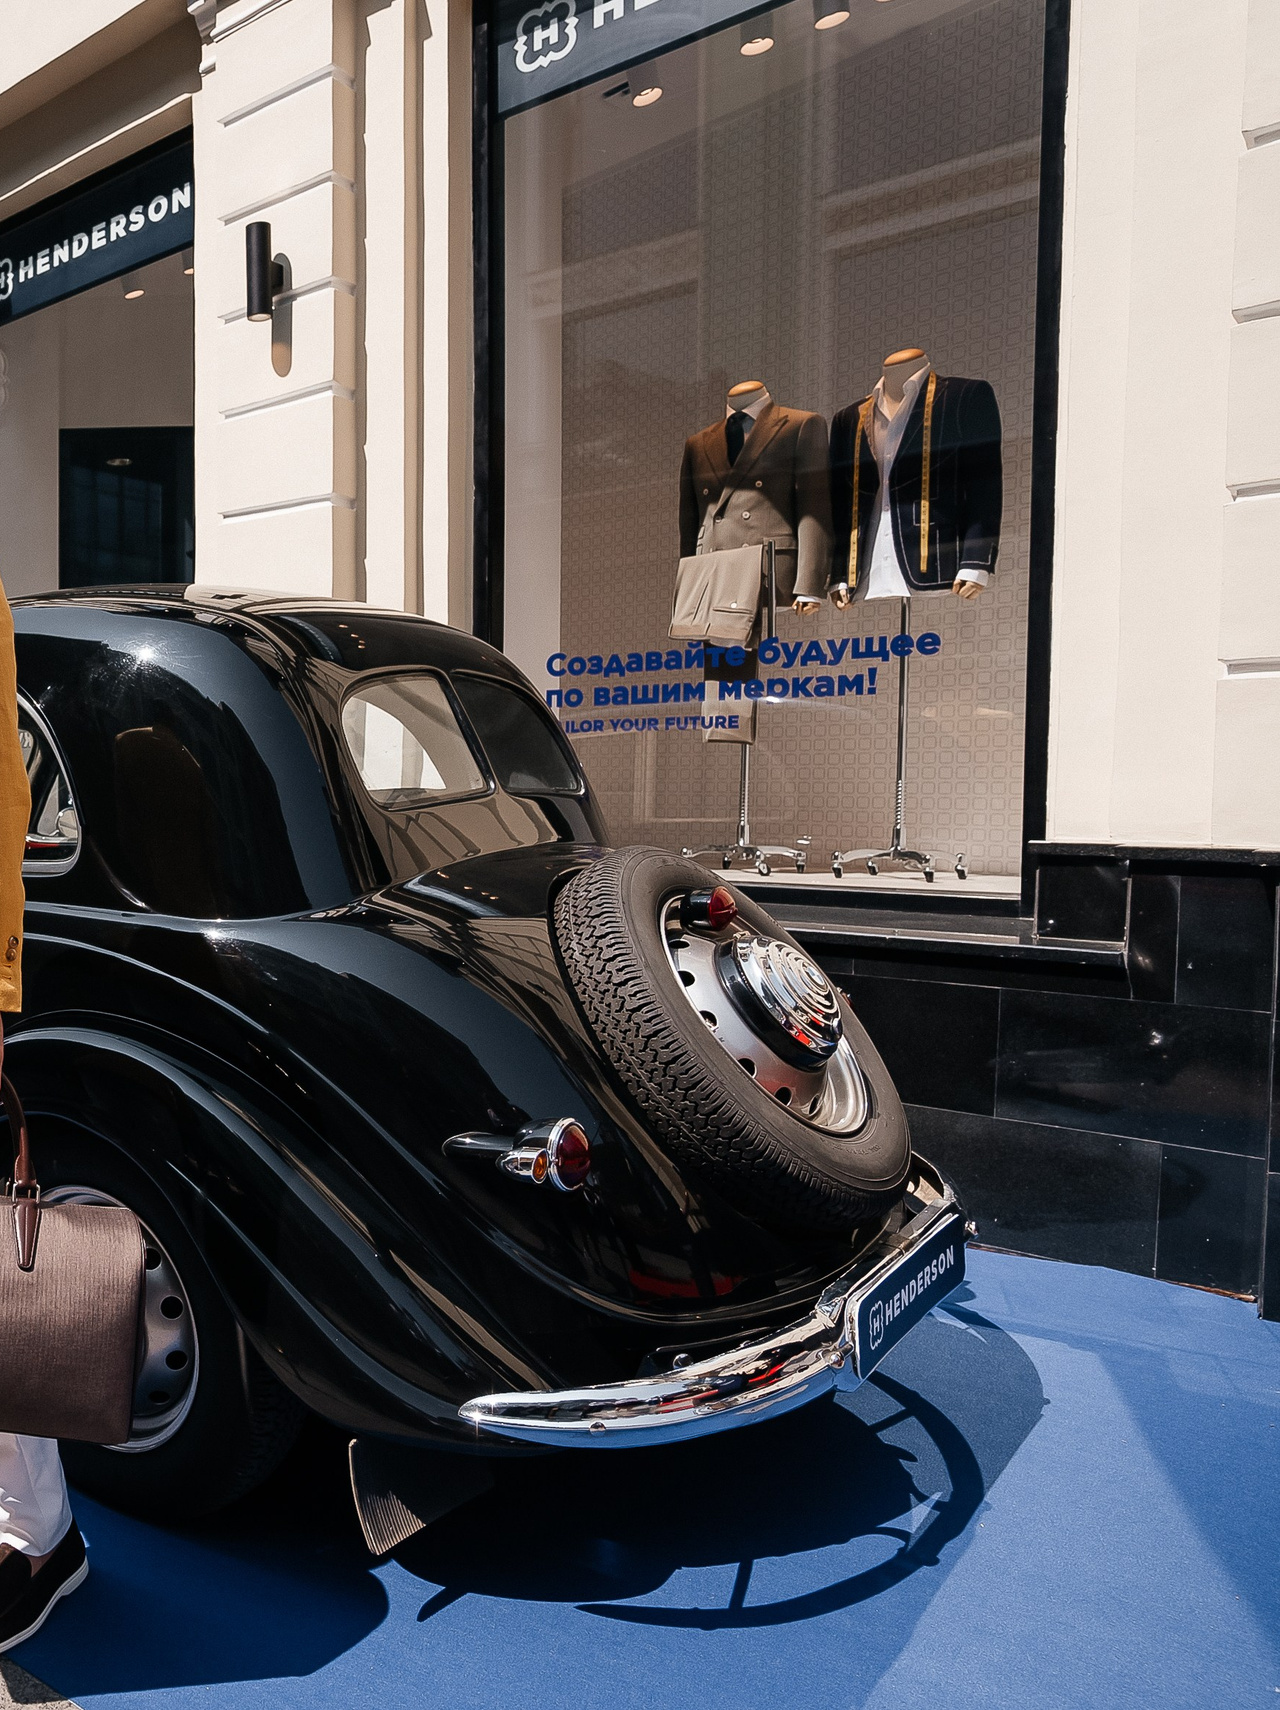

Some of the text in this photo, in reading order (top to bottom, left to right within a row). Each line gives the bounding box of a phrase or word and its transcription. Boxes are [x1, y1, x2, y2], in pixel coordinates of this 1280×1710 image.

[18, 182, 191, 283] HENDERSON
[546, 632, 942, 678] Создавайте будущее
[546, 667, 878, 708] по вашим меркам!
[558, 715, 740, 733] ILOR YOUR FUTURE
[885, 1245, 955, 1326] HENDERSON
